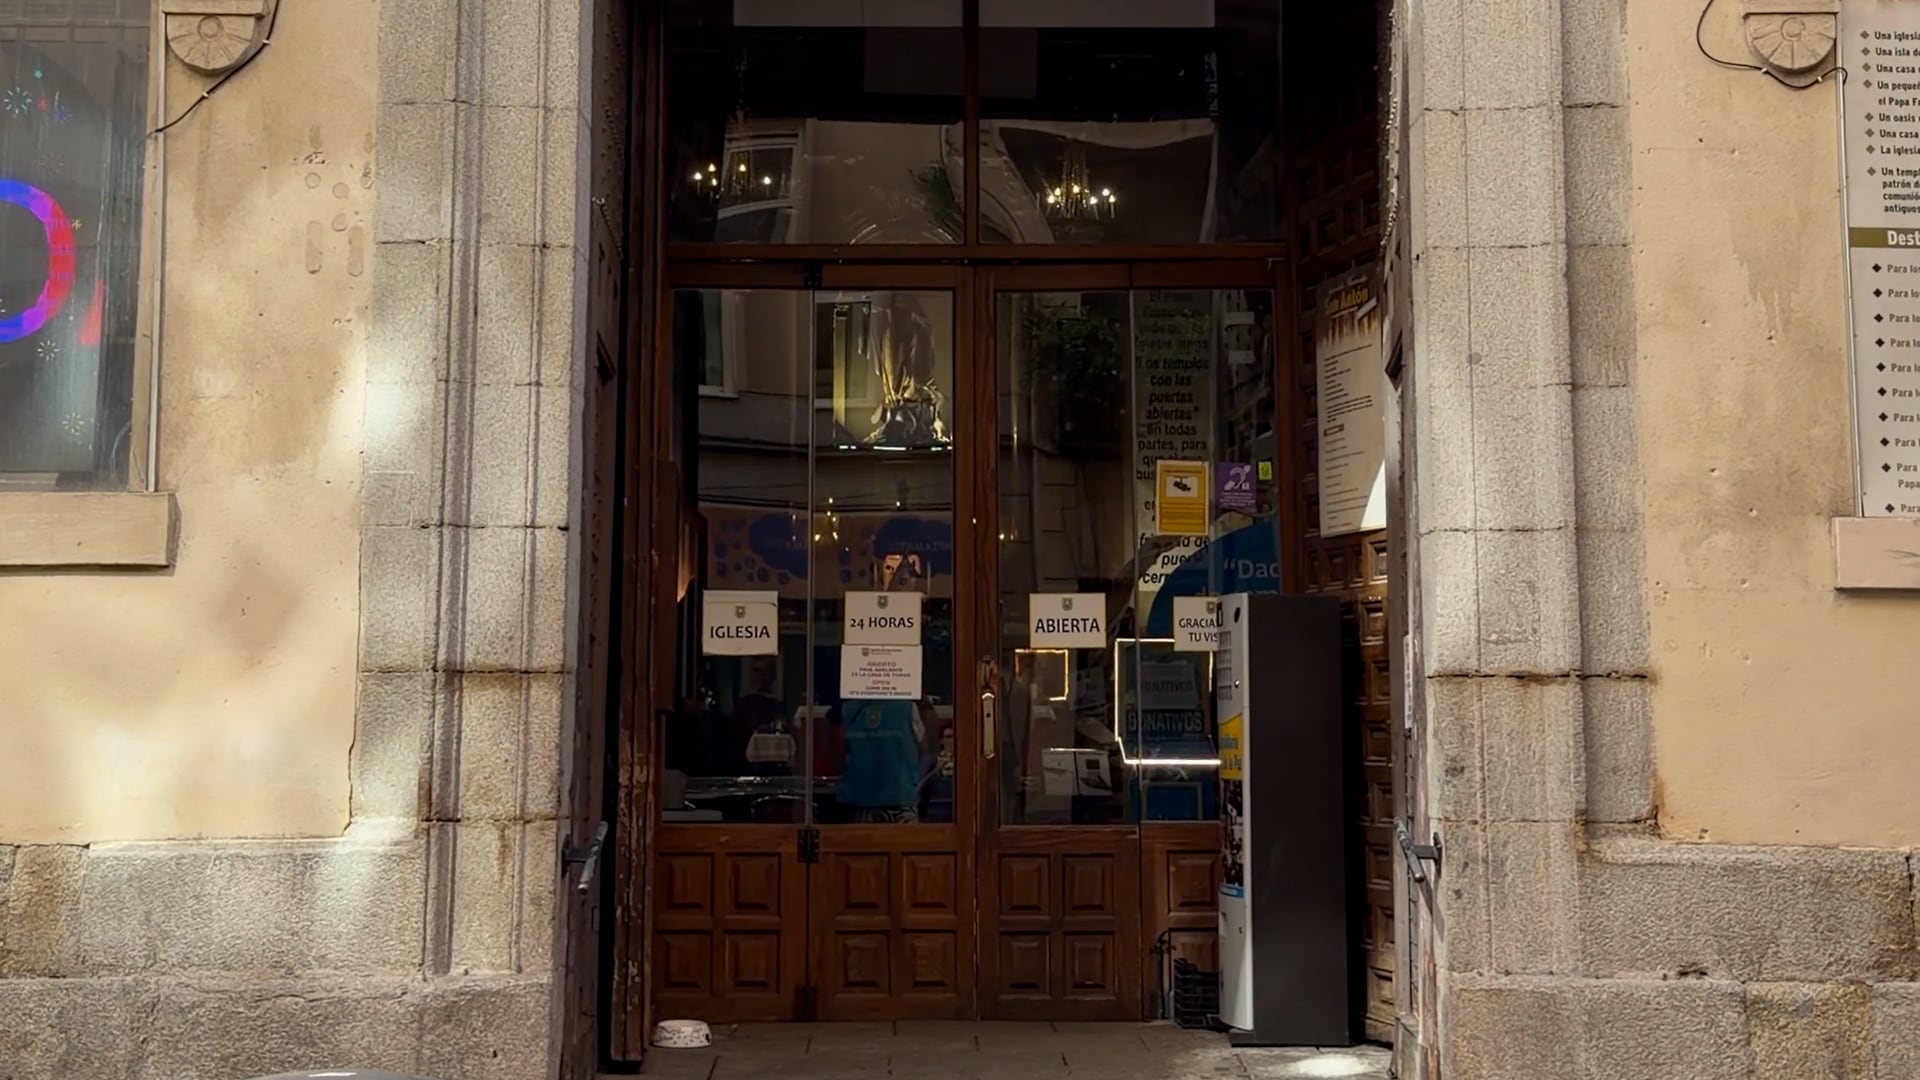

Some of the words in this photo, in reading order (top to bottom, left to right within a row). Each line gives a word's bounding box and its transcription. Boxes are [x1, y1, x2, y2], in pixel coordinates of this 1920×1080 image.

[1875, 31, 1891, 40] Una
[1876, 47, 1892, 56] Una
[1895, 47, 1910, 56] isla
[1876, 64, 1893, 73] Una
[1877, 80, 1889, 90] Un
[1878, 97, 1886, 106] el
[1889, 97, 1910, 108] Papa
[1879, 113, 1891, 122] Un
[1894, 113, 1916, 122] oasis
[1880, 129, 1897, 138] Una
[1880, 145, 1891, 154] La
[1881, 167, 1894, 176] Un
[1882, 179, 1911, 189] patrón
[1887, 264, 1908, 273] Para
[1888, 289, 1908, 298] Para
[1889, 314, 1910, 323] Para
[1890, 338, 1911, 347] Para
[1891, 363, 1912, 372] Para
[1150, 375, 1172, 386] con
[1892, 388, 1913, 397] Para
[1149, 391, 1193, 406] puertas
[1893, 413, 1914, 422] Para
[1165, 422, 1197, 436] todas
[1138, 438, 1179, 453] partes,
[1181, 441, 1207, 451] para
[1895, 438, 1916, 447] Para
[1896, 463, 1918, 472] Para
[1898, 479, 1920, 490] Papa
[1901, 504, 1920, 512] Para
[850, 618, 864, 630] 24
[868, 617, 914, 628] HORAS
[1035, 618, 1100, 633] ABIERTA
[710, 625, 770, 639] IGLESIA
[1188, 632, 1201, 642] TU
